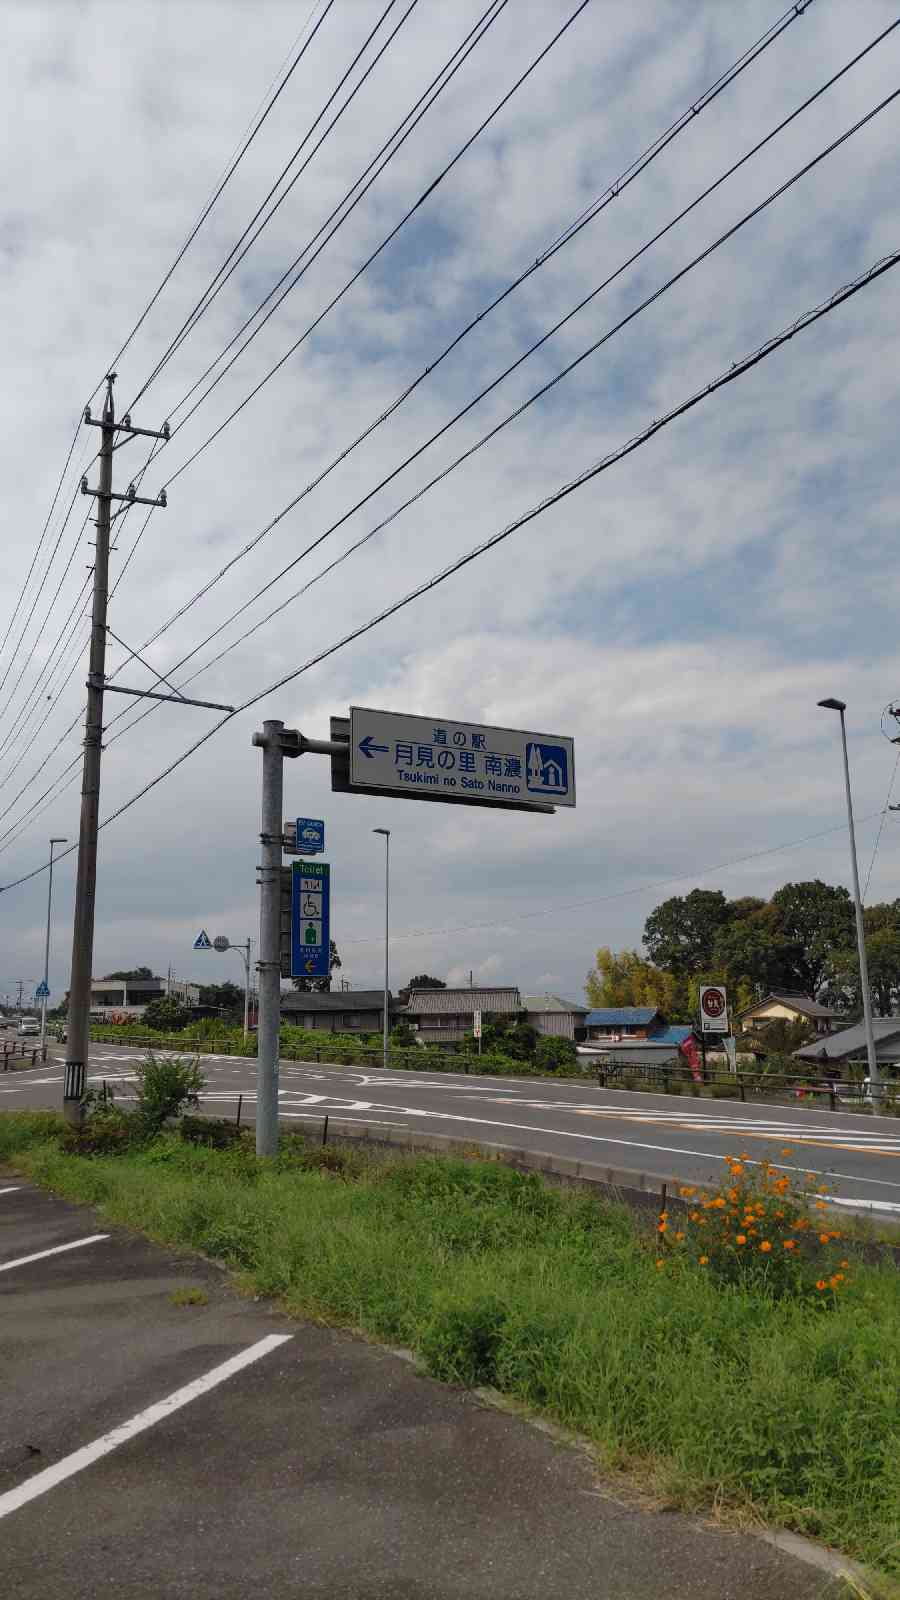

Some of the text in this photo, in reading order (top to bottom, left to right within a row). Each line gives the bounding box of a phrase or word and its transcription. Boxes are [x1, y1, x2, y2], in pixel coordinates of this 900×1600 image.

[432, 728, 487, 750] 道の駅
[395, 743, 522, 779] 月見の里 南濃
[398, 770, 520, 794] Tsukimi no Sato Nanno
[300, 864, 323, 874] Toilet
